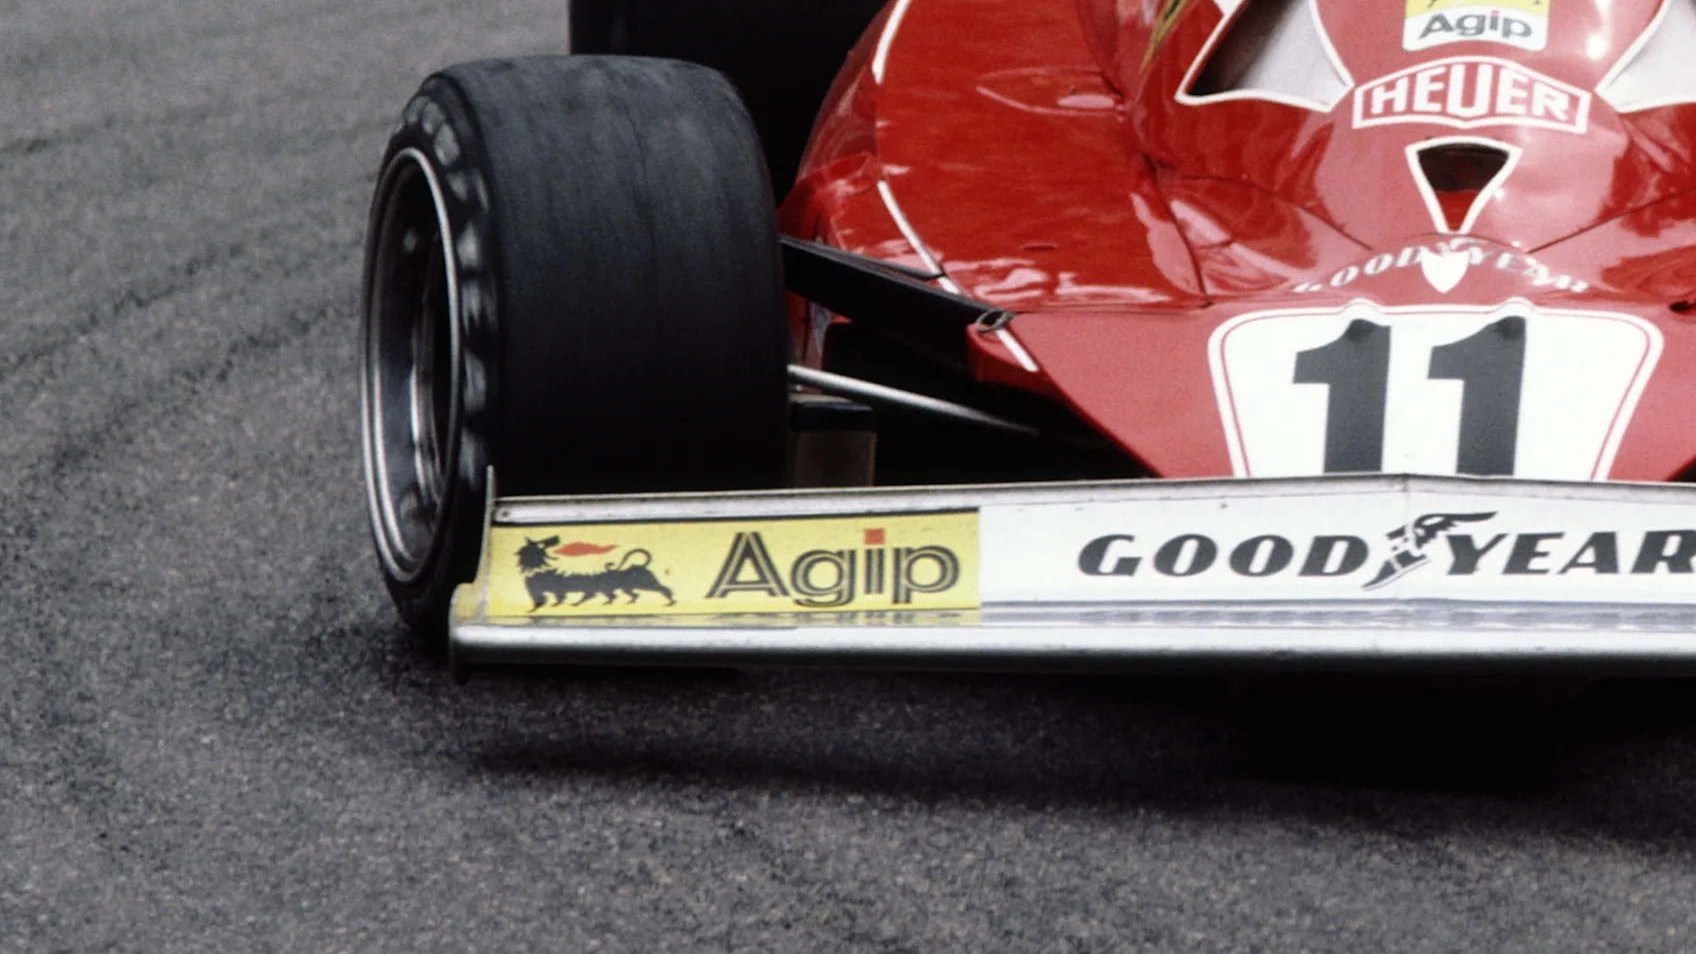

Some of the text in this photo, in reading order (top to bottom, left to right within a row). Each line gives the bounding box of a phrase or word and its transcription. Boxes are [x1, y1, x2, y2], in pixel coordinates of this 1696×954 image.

[1417, 9, 1533, 40] Agip
[1370, 64, 1570, 121] HEUER
[1293, 315, 1527, 476] 11
[704, 527, 960, 607] Agip
[1077, 533, 1370, 577] GOOD
